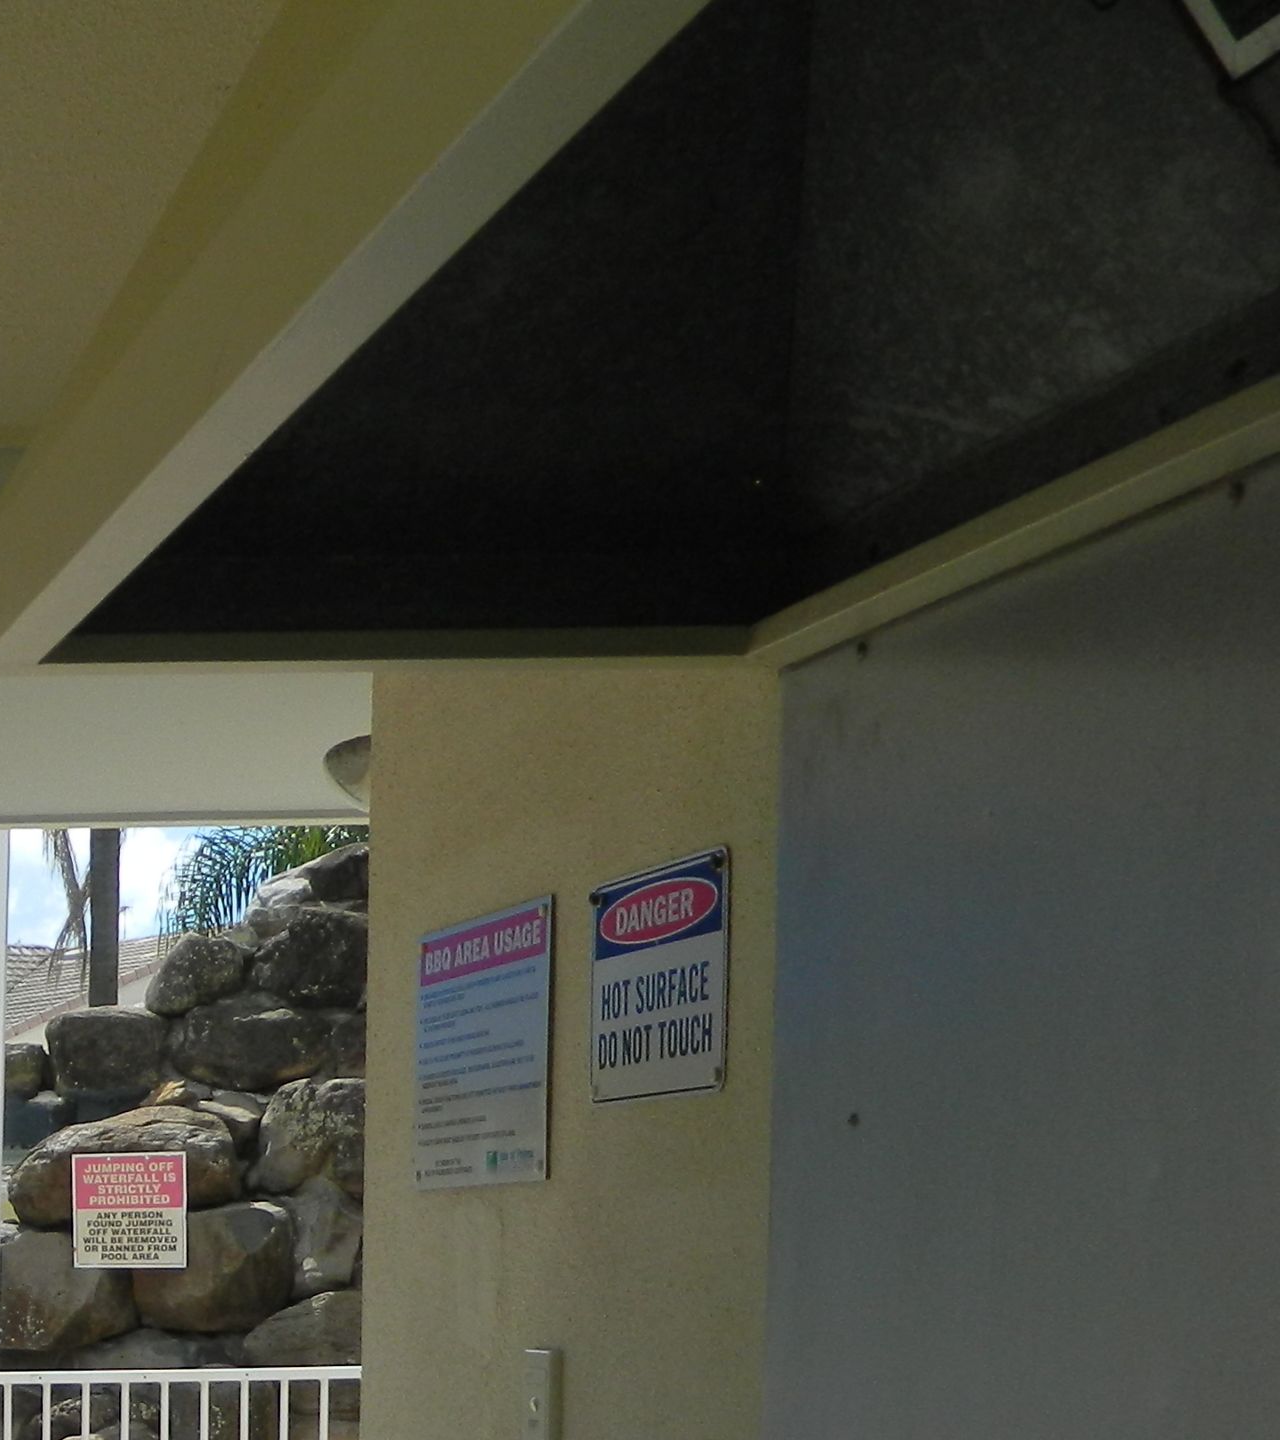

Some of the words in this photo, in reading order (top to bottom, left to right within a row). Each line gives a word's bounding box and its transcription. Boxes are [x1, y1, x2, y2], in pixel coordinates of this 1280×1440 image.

[615, 888, 694, 936] DANGER
[425, 948, 451, 975] BBQ
[454, 936, 490, 966] AREA
[494, 919, 541, 955] USAGE
[602, 980, 631, 1021] HOT
[636, 961, 710, 1014] SURFACE
[598, 1031, 618, 1070] DO
[622, 1023, 653, 1066] NOT
[658, 1013, 713, 1060] TOUCH
[84, 1163, 145, 1173] JUMPING
[149, 1162, 174, 1171] OFF
[83, 1173, 159, 1184] WATERFALL
[163, 1173, 176, 1183] IS
[98, 1184, 161, 1194] STRICTLY
[89, 1195, 170, 1205] PROHIBITED
[121, 1211, 163, 1219] PERSON
[87, 1220, 122, 1228] FOUND
[125, 1219, 173, 1227] JUMPING
[89, 1228, 109, 1236] OFF
[111, 1227, 171, 1235] WATERFALL
[111, 1236, 124, 1244] BE
[101, 1244, 144, 1252] BANNED
